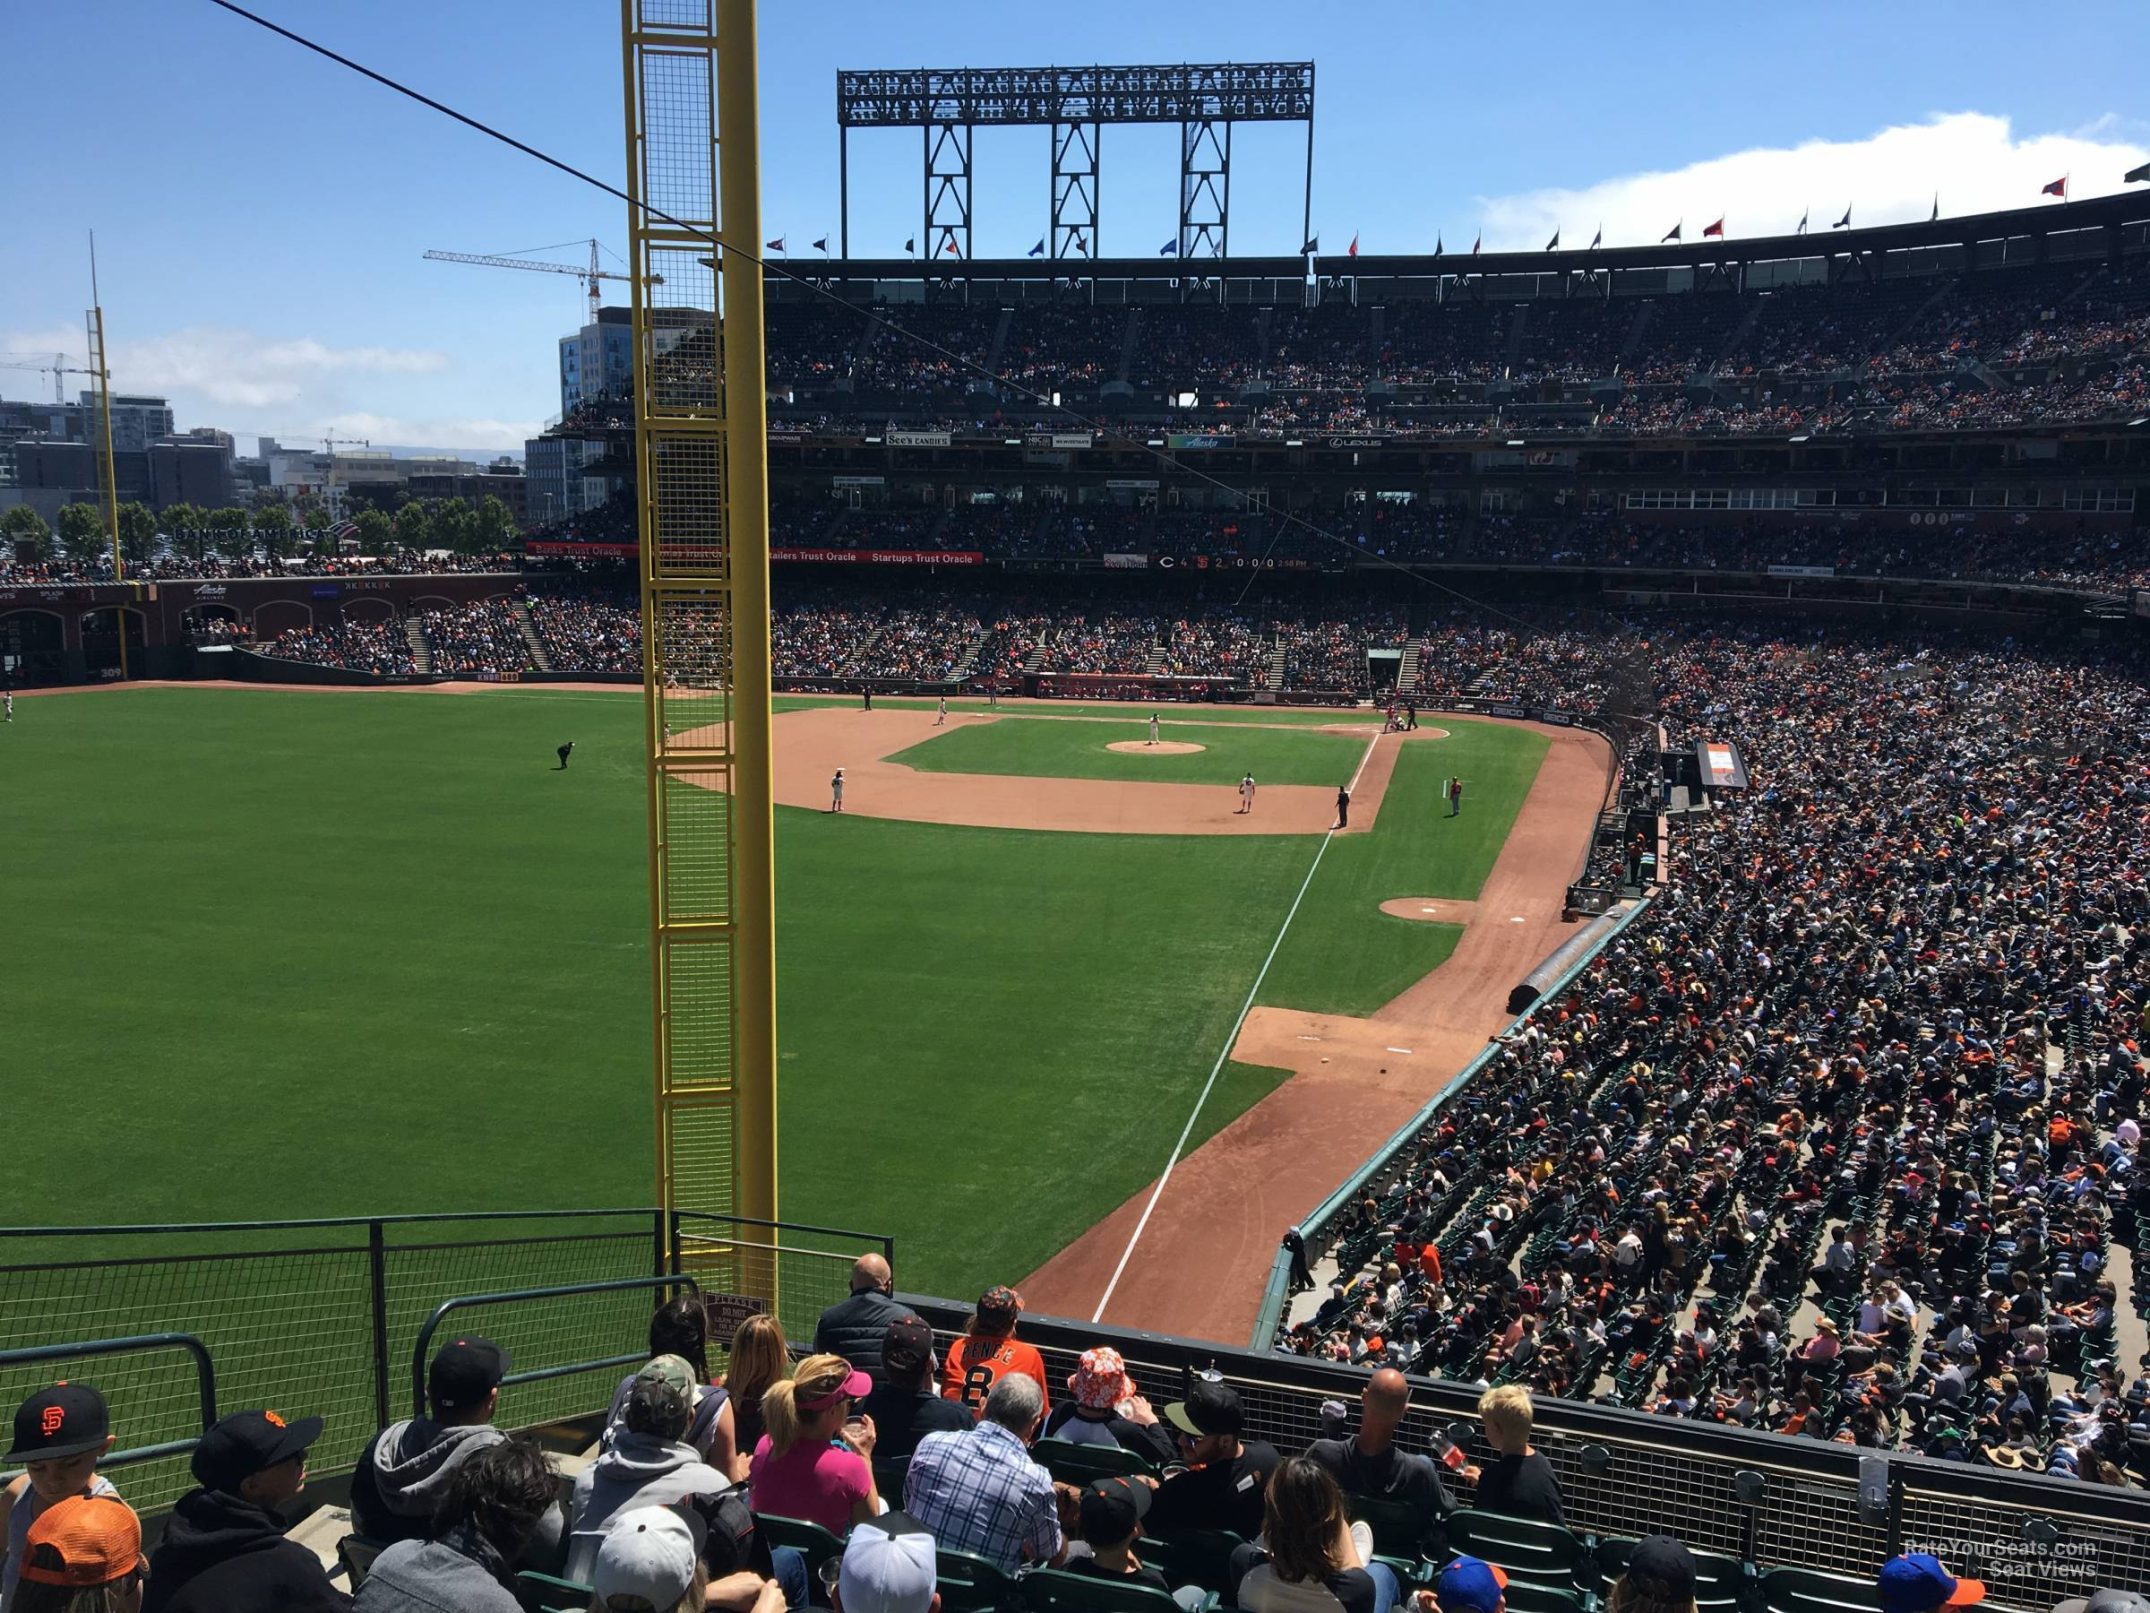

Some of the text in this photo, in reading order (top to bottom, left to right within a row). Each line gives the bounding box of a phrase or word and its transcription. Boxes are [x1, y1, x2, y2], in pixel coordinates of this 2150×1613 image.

[888, 435, 913, 444] See's
[1186, 437, 1218, 448] Alaska
[1343, 439, 1382, 447] LEXUS
[174, 528, 325, 540] BANK OF AMERICA
[535, 544, 622, 557] Banks Trust Oracle
[800, 551, 824, 561] Trust
[826, 552, 857, 561] Oracle
[872, 553, 973, 564] Startups Trust Oracle
[1215, 557, 1223, 568] 2
[193, 584, 227, 595] Alaska
[100, 667, 122, 678] 309
[1492, 706, 1525, 718] GEICO
[1543, 712, 1570, 724] GEICO
[962, 1341, 1016, 1365] PENCE
[961, 1365, 995, 1409] 8
[41, 1406, 65, 1436] SF
